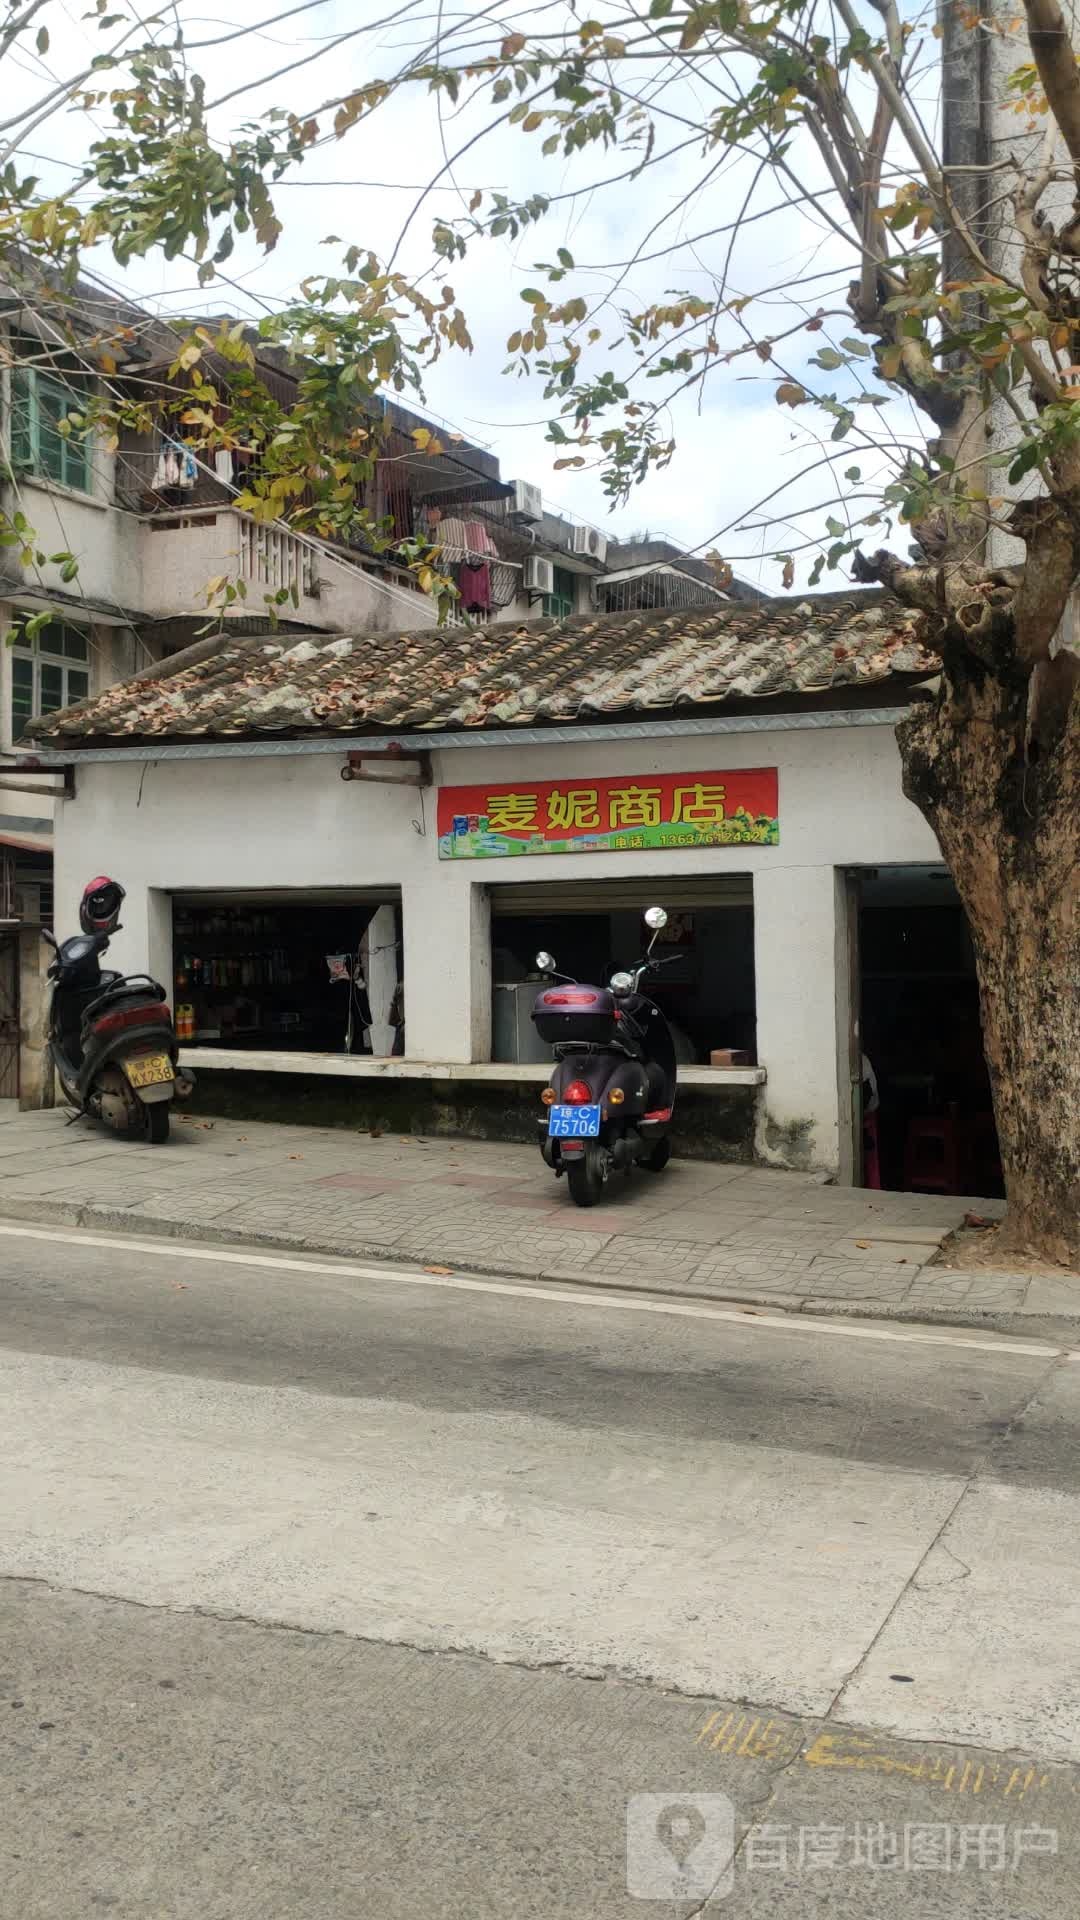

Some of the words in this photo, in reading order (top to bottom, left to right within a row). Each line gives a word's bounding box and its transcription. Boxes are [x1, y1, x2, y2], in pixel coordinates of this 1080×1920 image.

[486, 783, 726, 833] 麦妮商店
[553, 1119, 596, 1134] 75706
